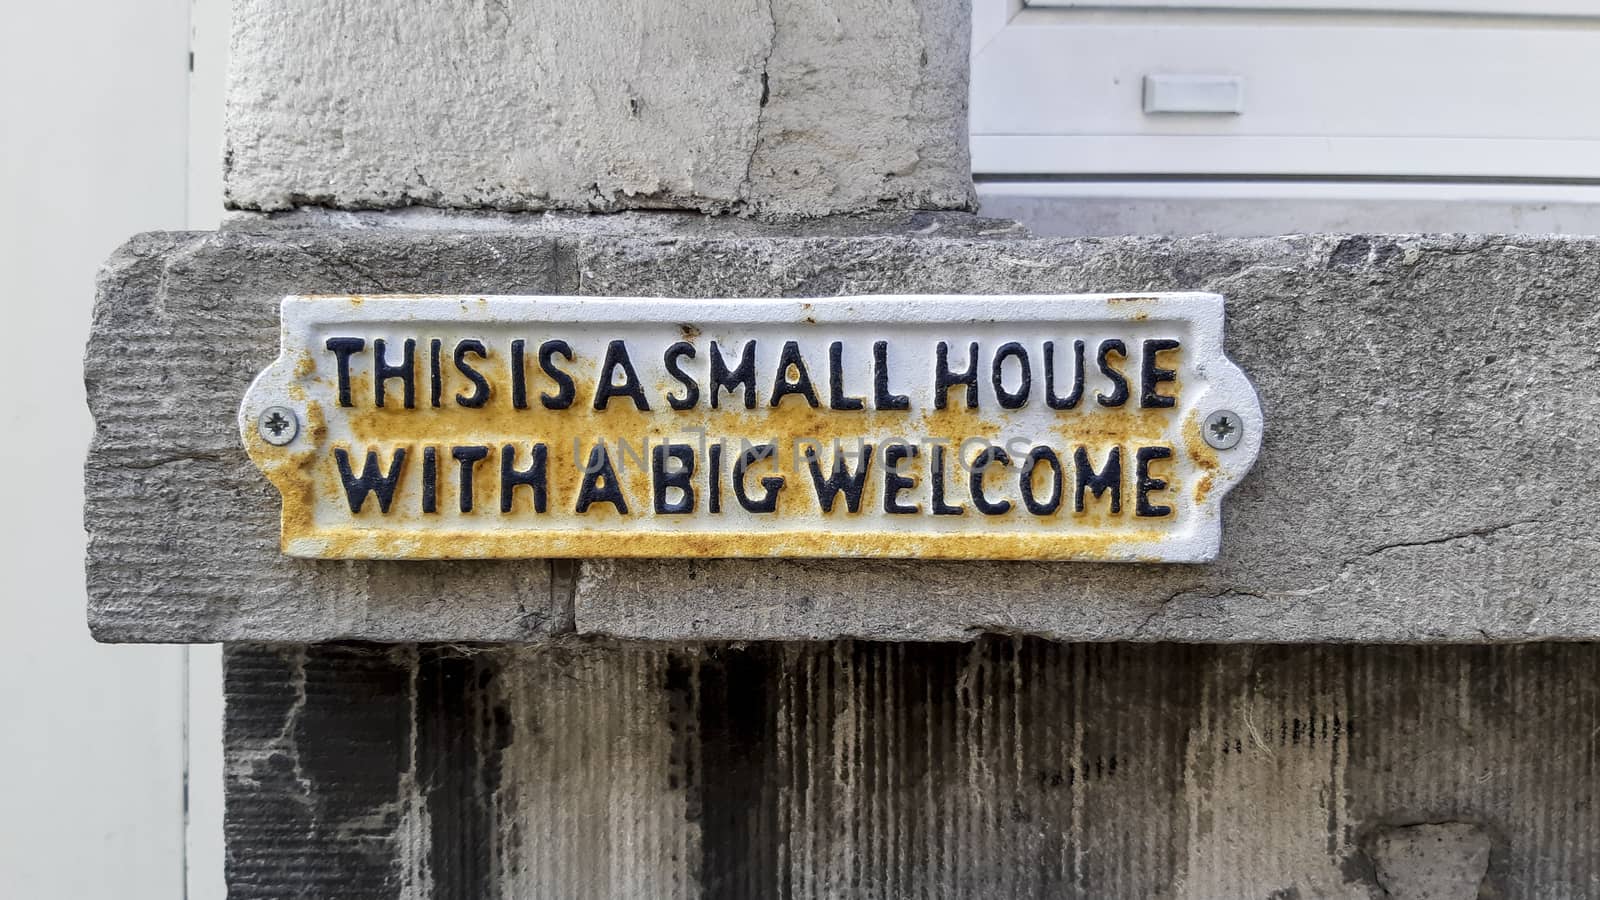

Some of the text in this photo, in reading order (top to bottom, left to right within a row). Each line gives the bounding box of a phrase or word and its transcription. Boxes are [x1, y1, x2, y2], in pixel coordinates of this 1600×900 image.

[326, 337, 1180, 411] THIS IS A SMALL HOUSE
[335, 443, 1172, 516] WITH A BIG WELCOME
